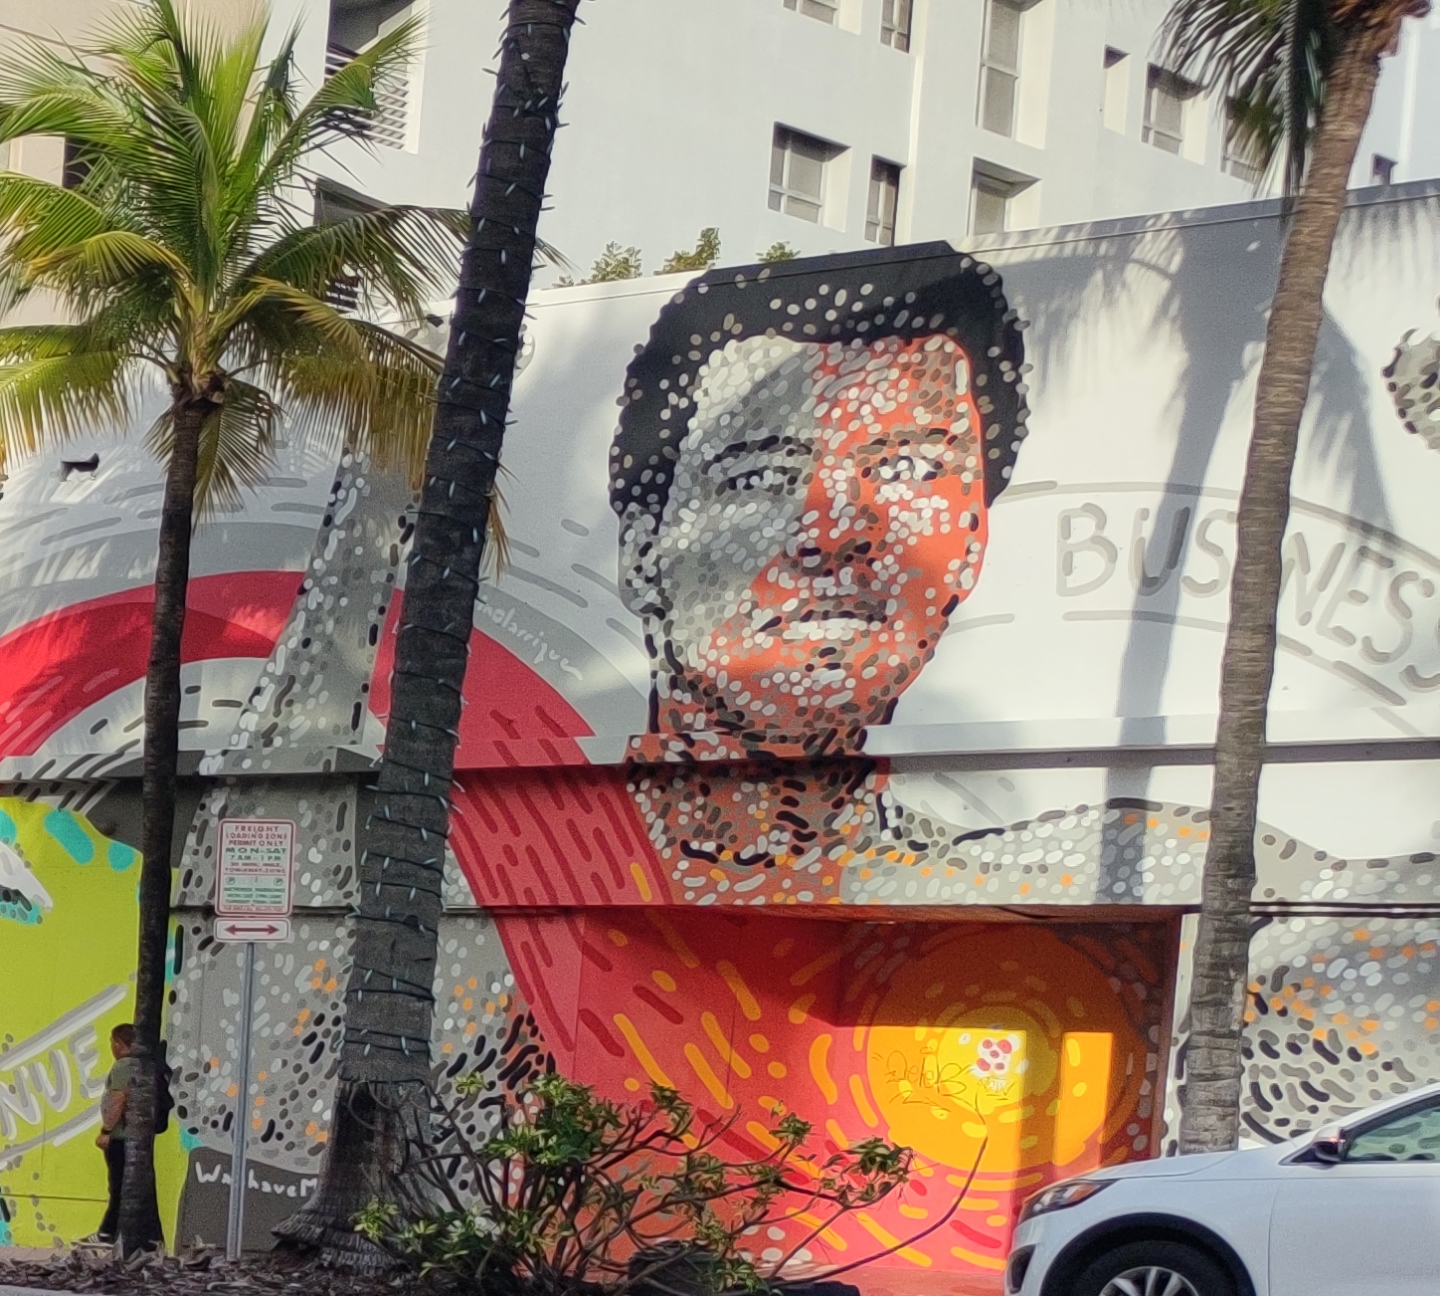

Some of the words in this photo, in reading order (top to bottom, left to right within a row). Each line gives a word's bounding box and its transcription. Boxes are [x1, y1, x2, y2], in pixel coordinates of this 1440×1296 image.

[1056, 502, 1440, 692] BUSNES
[235, 825, 279, 833] FREIGHT
[226, 832, 263, 840] LOADING
